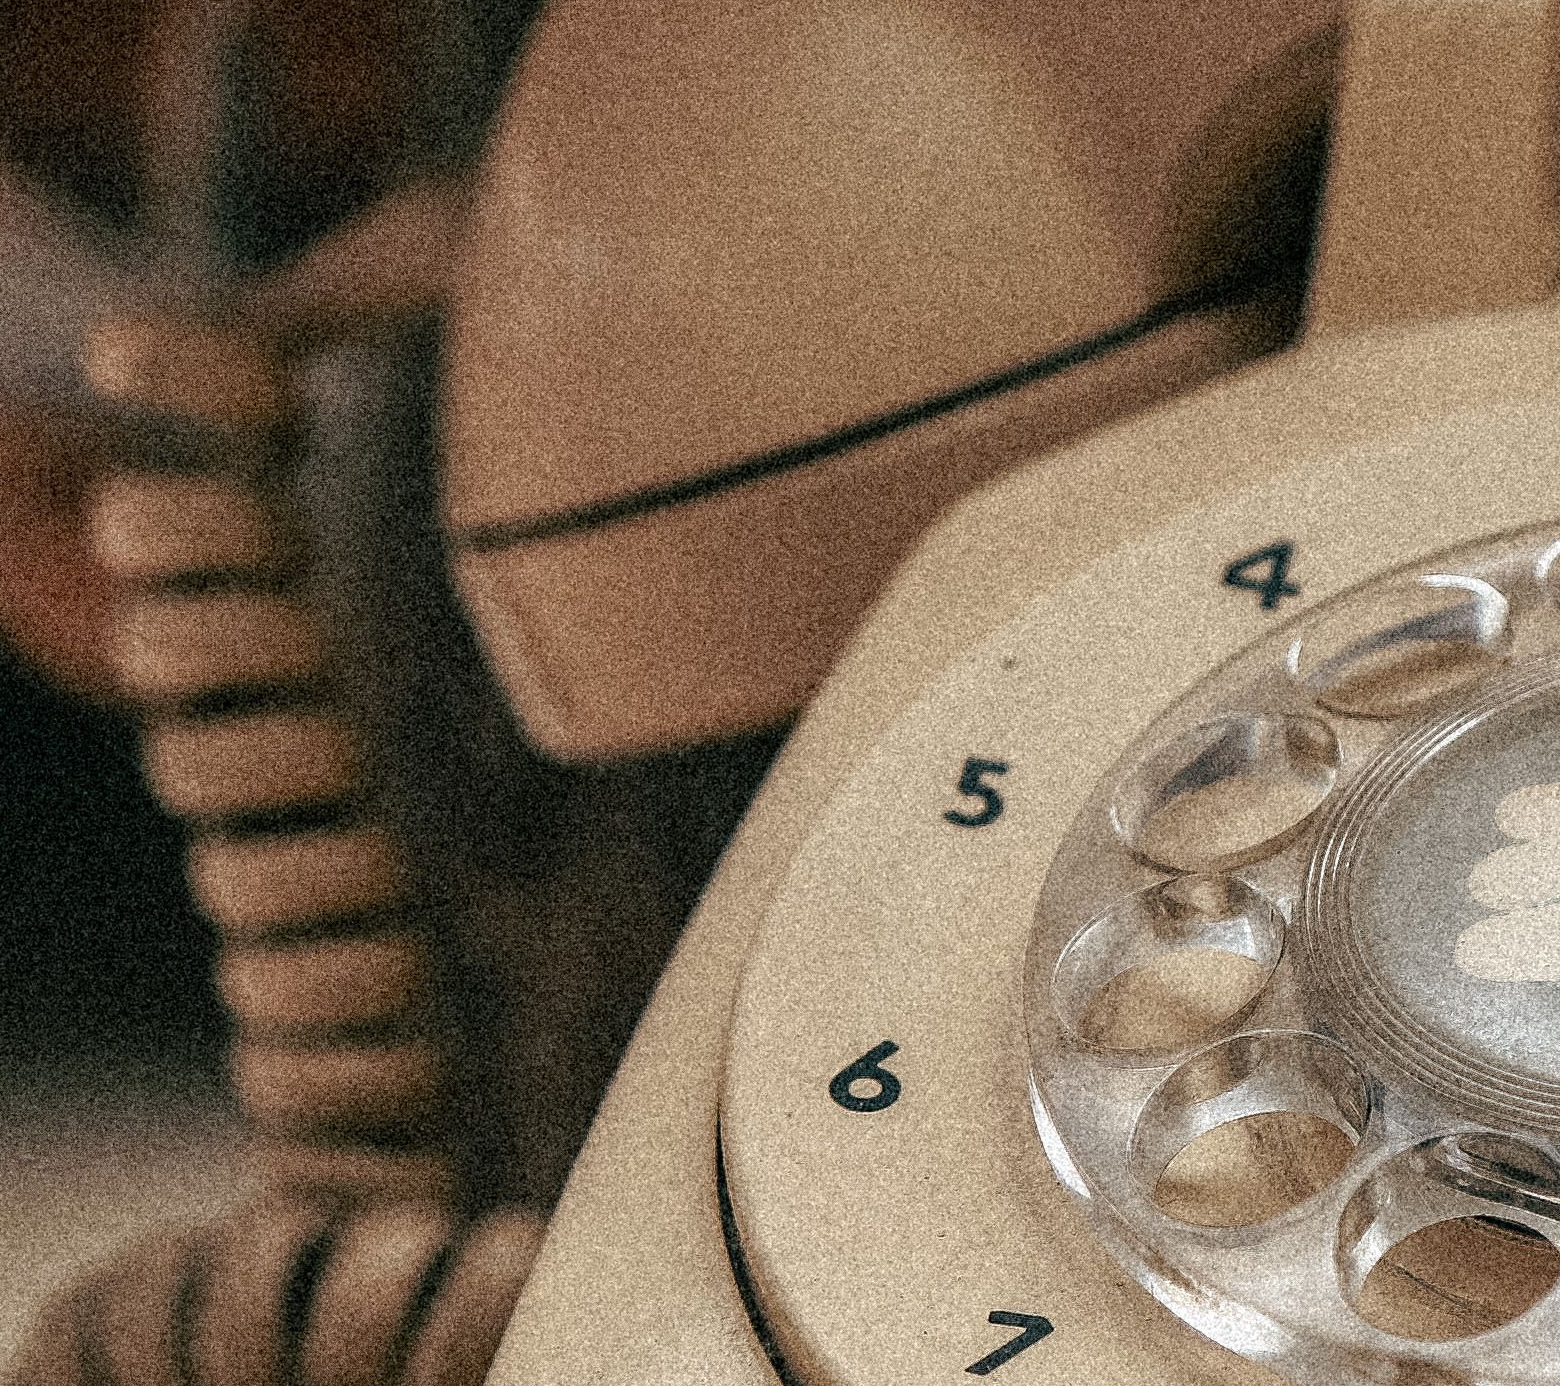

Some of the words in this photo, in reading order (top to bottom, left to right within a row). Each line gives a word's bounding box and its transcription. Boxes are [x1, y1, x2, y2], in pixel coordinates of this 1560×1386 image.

[1224, 544, 1296, 608] 4
[946, 758, 1006, 828] 5
[829, 1041, 901, 1113] 6
[965, 1310, 1054, 1376] 7
